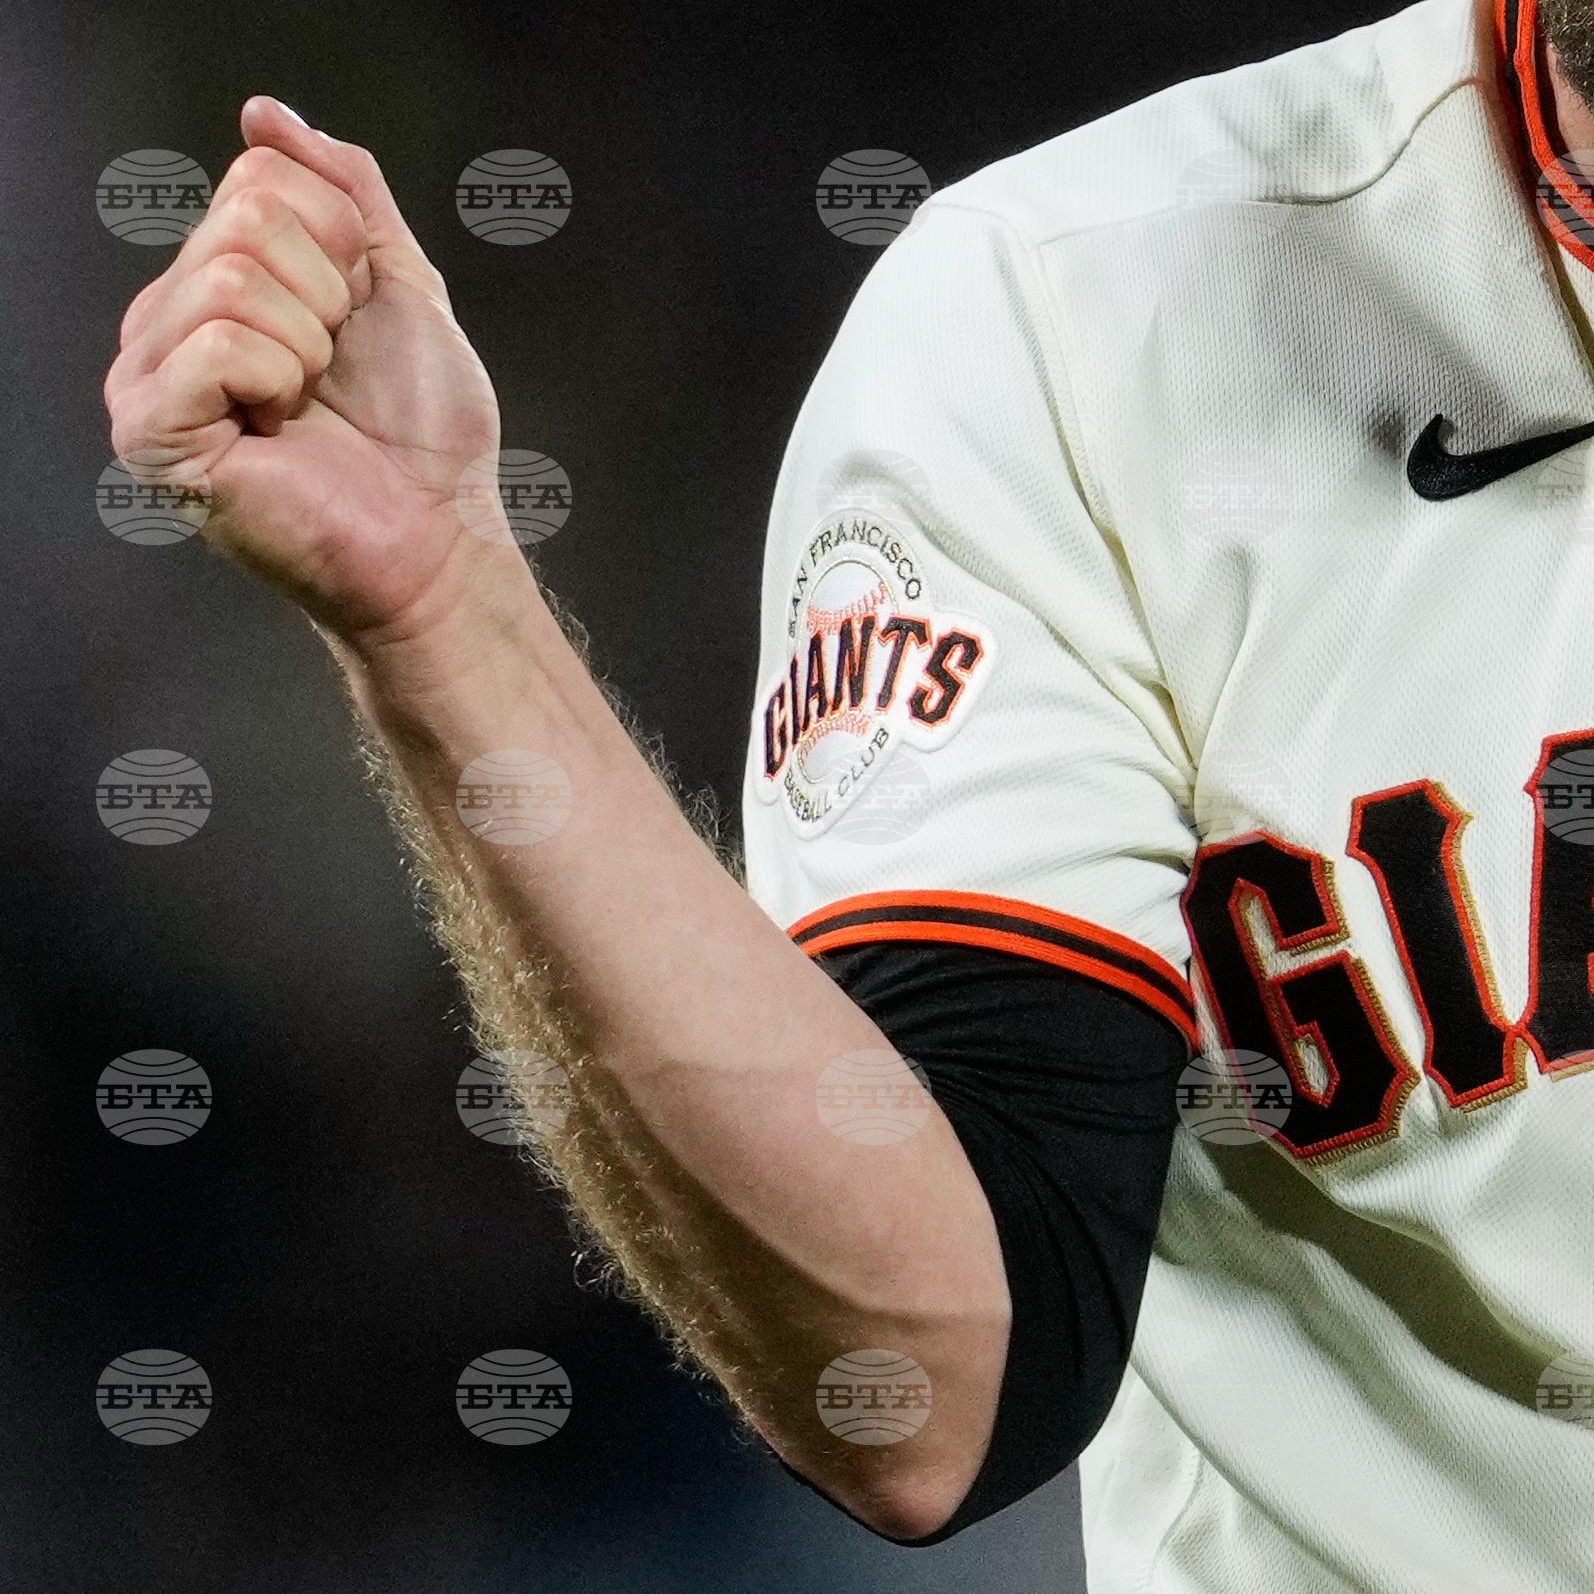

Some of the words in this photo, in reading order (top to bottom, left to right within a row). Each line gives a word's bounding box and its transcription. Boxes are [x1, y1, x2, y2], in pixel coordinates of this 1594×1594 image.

[788, 564, 808, 638] SAN
[808, 518, 922, 600] FRANCISCO
[763, 613, 984, 780] GIANTS
[838, 727, 890, 798] CLUB
